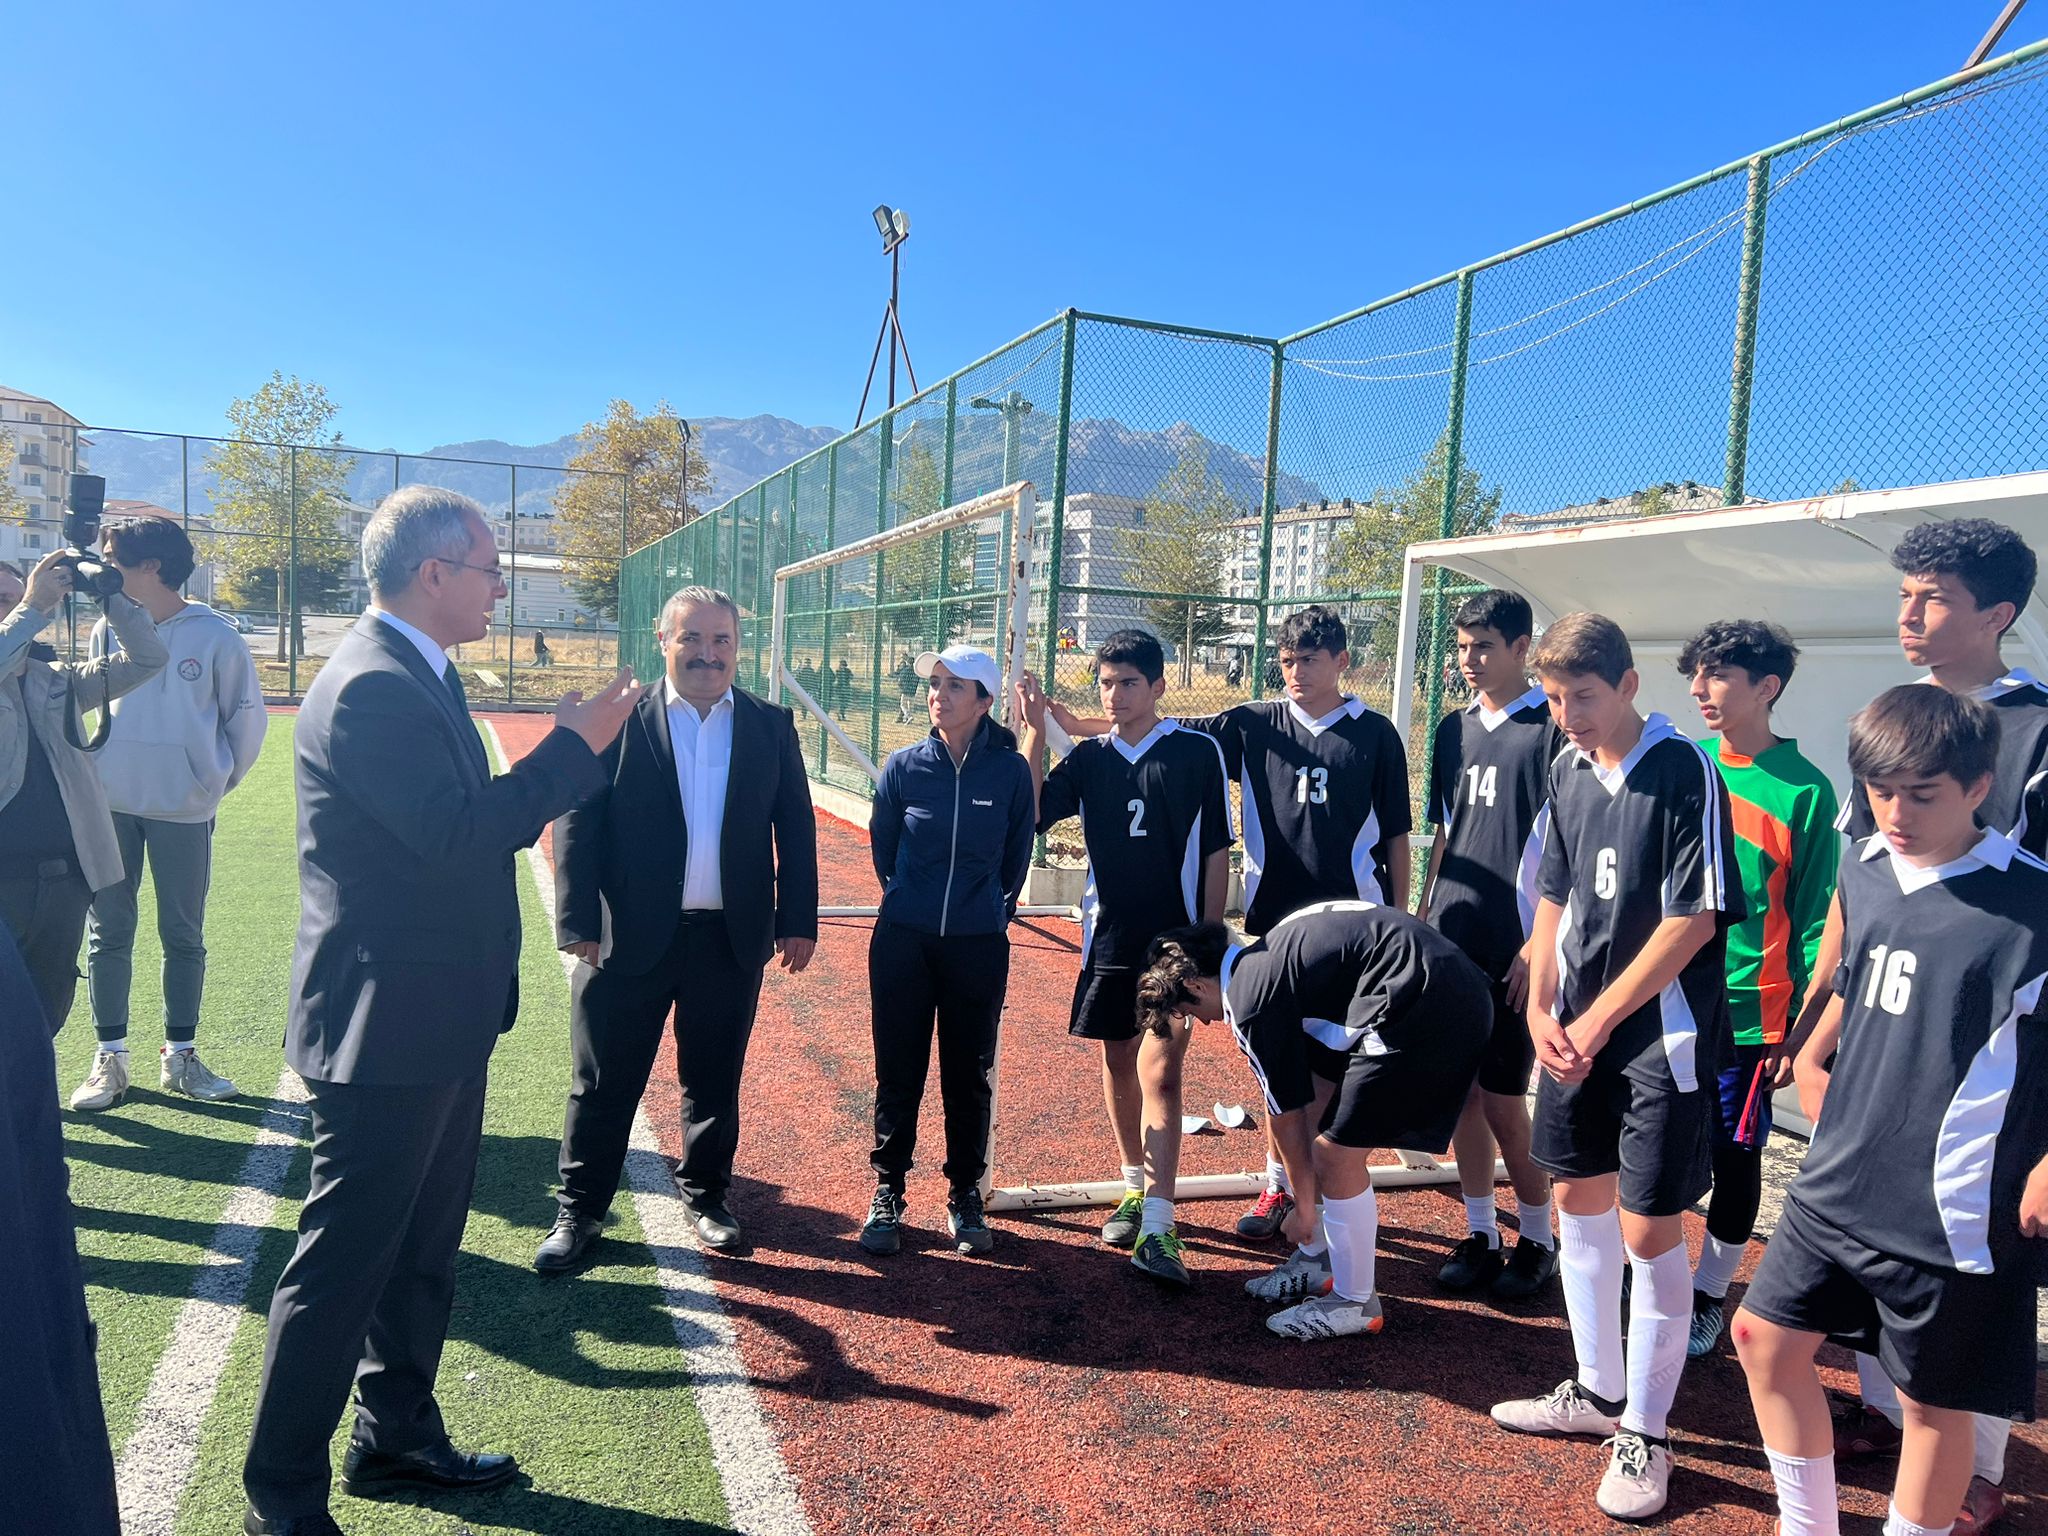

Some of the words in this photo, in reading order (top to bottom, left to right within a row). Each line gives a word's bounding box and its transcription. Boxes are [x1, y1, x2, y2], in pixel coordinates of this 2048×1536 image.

[1295, 766, 1328, 804] 13
[1466, 764, 1497, 807] 14
[1127, 798, 1147, 837] 2
[1594, 847, 1617, 900] 6
[1864, 944, 1917, 1016] 16
